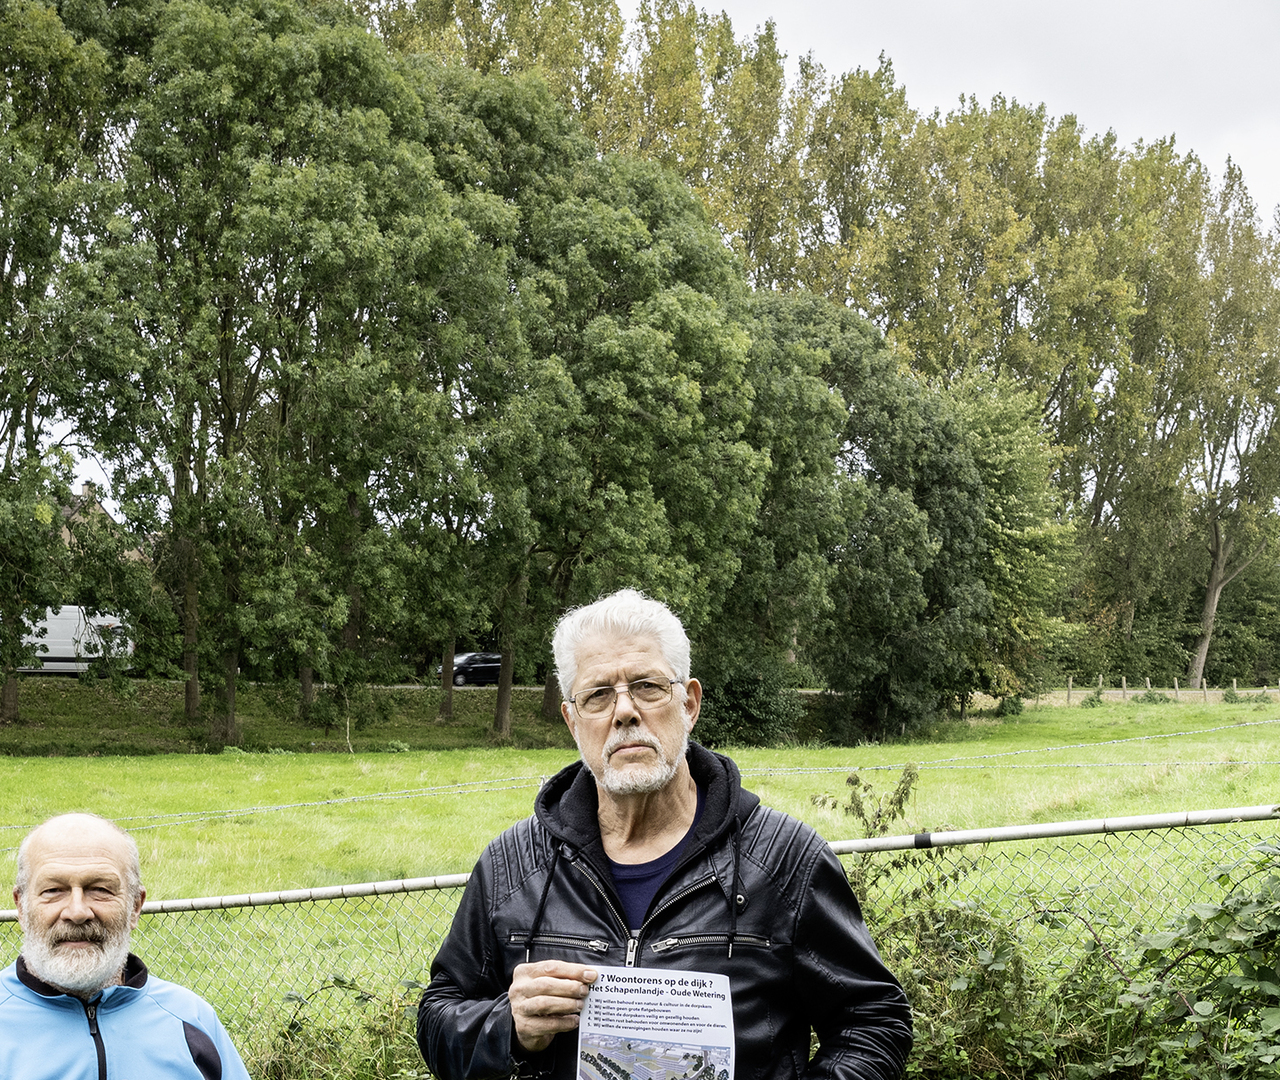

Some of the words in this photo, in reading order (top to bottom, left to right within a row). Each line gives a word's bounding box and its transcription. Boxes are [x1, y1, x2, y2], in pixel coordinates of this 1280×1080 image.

[601, 974, 604, 982] ?
[607, 975, 662, 985] Woontorens
[664, 979, 676, 987] op
[678, 978, 689, 987] de
[691, 979, 707, 989] dijk
[709, 980, 713, 988] ?
[589, 985, 603, 993] Het
[605, 986, 664, 996] Schapenlandje
[670, 989, 691, 997] Oude
[693, 990, 725, 1001] Wetering
